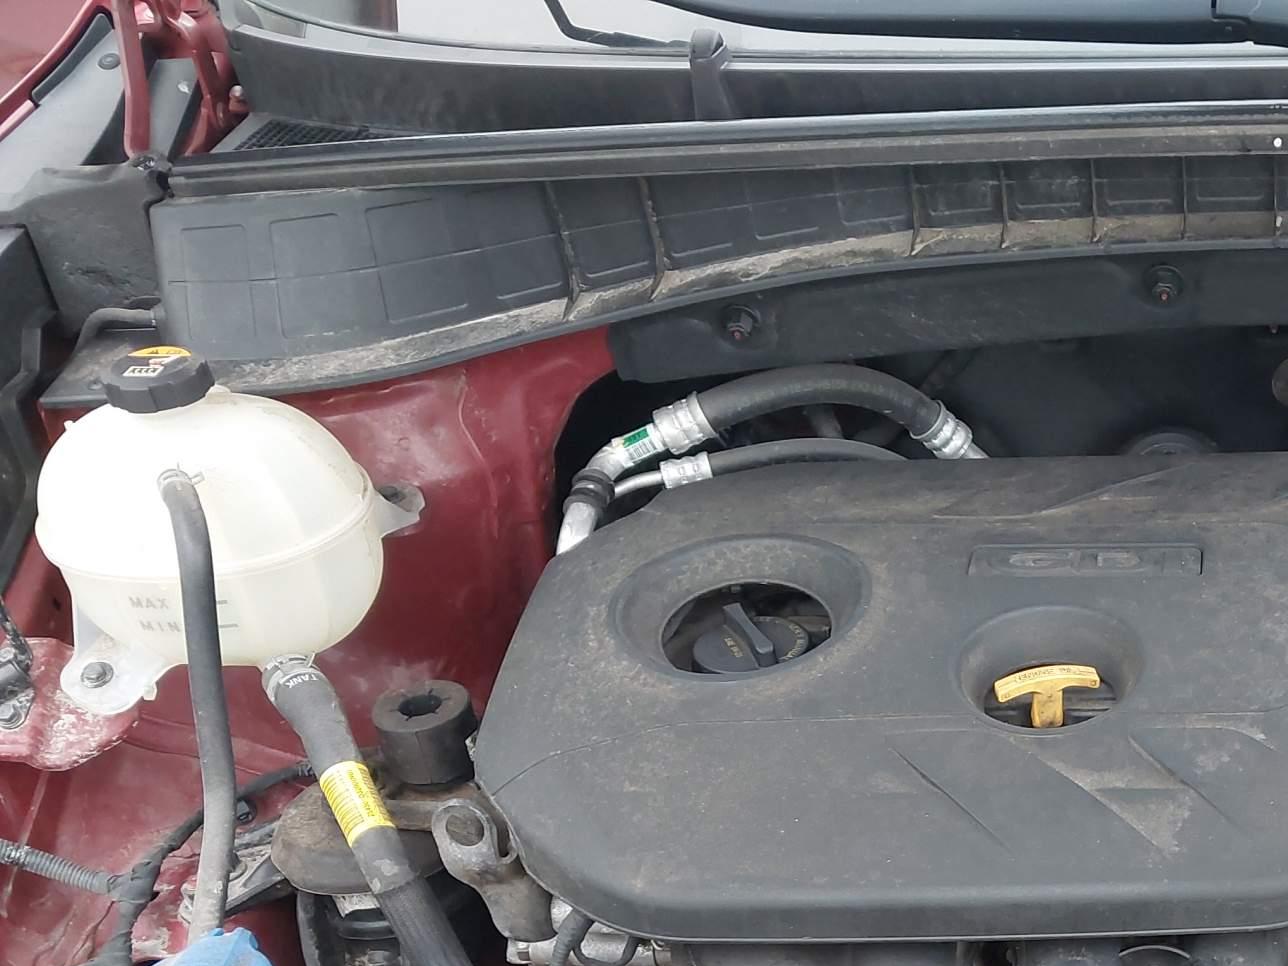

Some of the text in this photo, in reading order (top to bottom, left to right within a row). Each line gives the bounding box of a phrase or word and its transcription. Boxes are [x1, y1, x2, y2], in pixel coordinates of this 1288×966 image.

[128, 595, 169, 609] MAX
[139, 620, 181, 633] MIN
[285, 673, 320, 689] TANK
